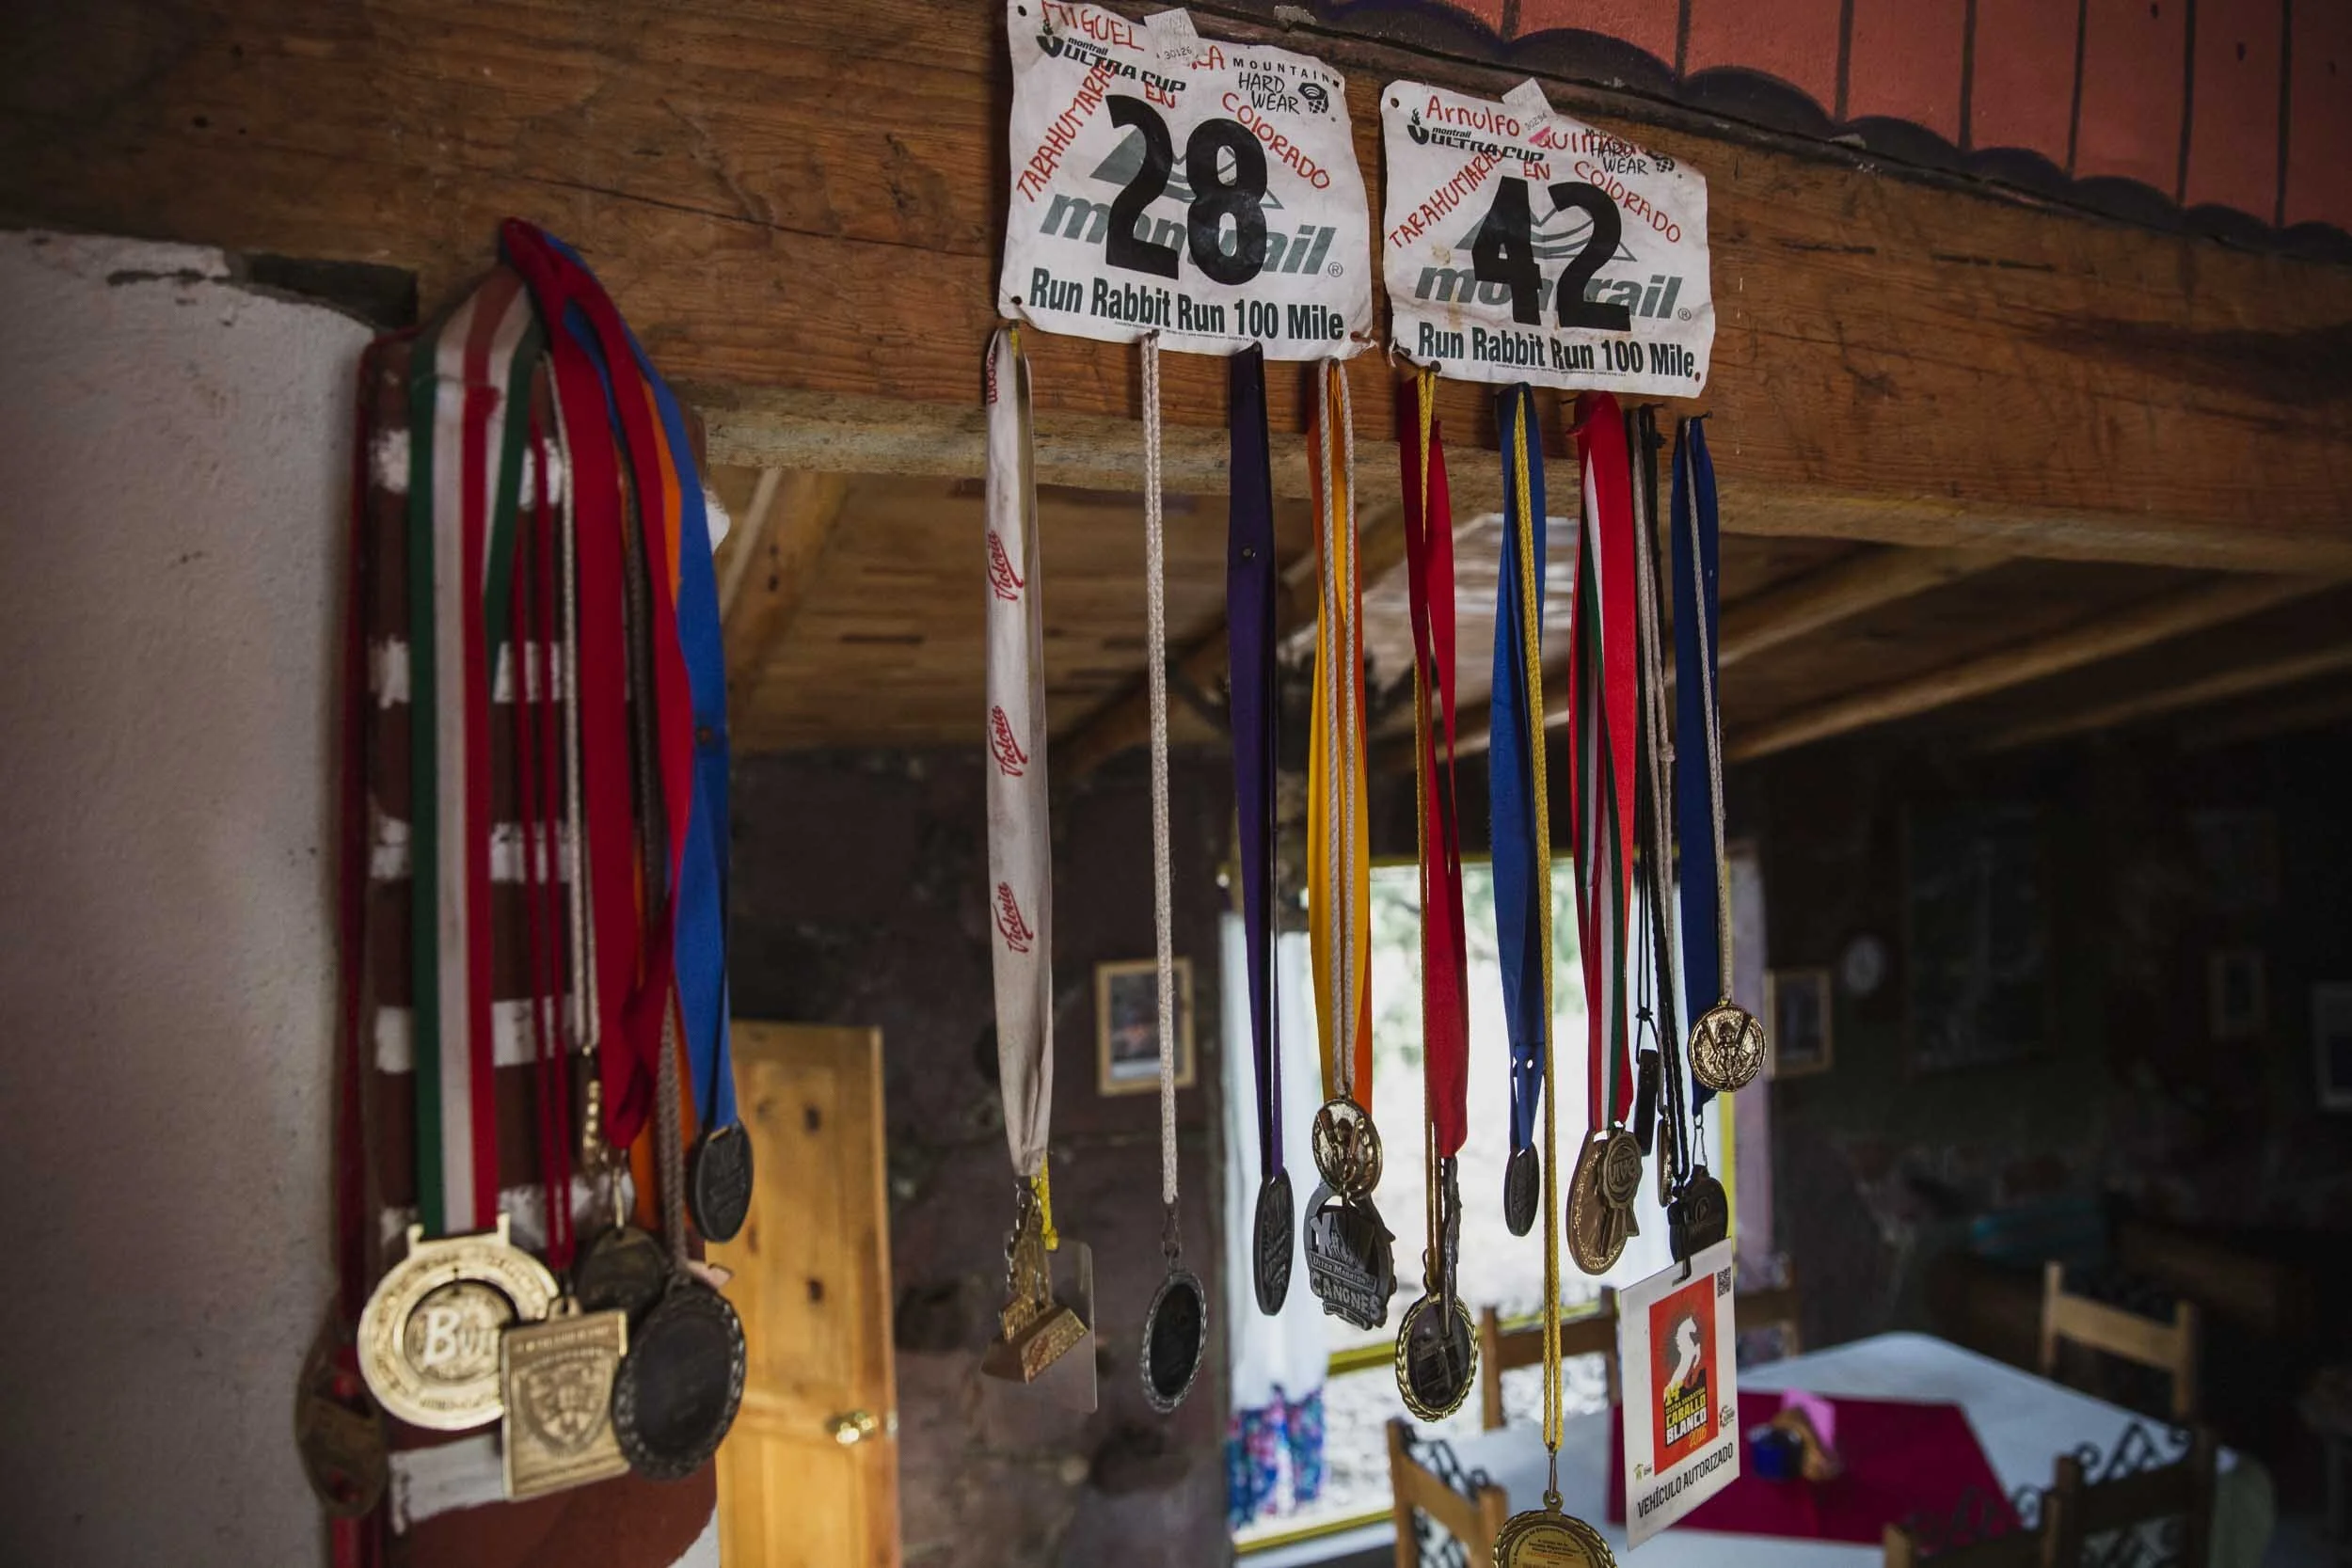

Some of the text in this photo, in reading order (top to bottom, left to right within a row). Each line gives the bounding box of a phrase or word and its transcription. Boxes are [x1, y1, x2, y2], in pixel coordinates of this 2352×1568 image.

[1041, 0, 1144, 52] MIGUEL
[1068, 37, 1108, 55] montrail
[1063, 44, 1187, 93] ULTRA CUP
[1232, 56, 1329, 84] MOUNTAIN
[1238, 71, 1285, 94] HARD
[1144, 82, 1176, 109] EN
[1251, 90, 1300, 115] WEAR
[1431, 134, 1545, 164] ULTRA CUP
[1432, 127, 1472, 139] montrail
[1523, 161, 1551, 182] EN
[1602, 156, 1648, 176] WEAR
[1105, 94, 1268, 286] 28
[1471, 175, 1632, 332] 42
[1029, 267, 1084, 313] Run
[1090, 277, 1170, 329] Rabbit
[1176, 293, 1226, 336] Run
[1233, 298, 1279, 341] 100
[1287, 303, 1344, 341] Mile
[1418, 322, 1695, 378] Run Rabbit Run 100 Mile
[989, 705, 1027, 778] Victoria
[992, 881, 1034, 955] Victoria
[1666, 1393, 1707, 1430] CABALLO
[1666, 1406, 1708, 1446] BLANCO
[1637, 1442, 1733, 1519] VEHÍCULO AUTORIZADO
